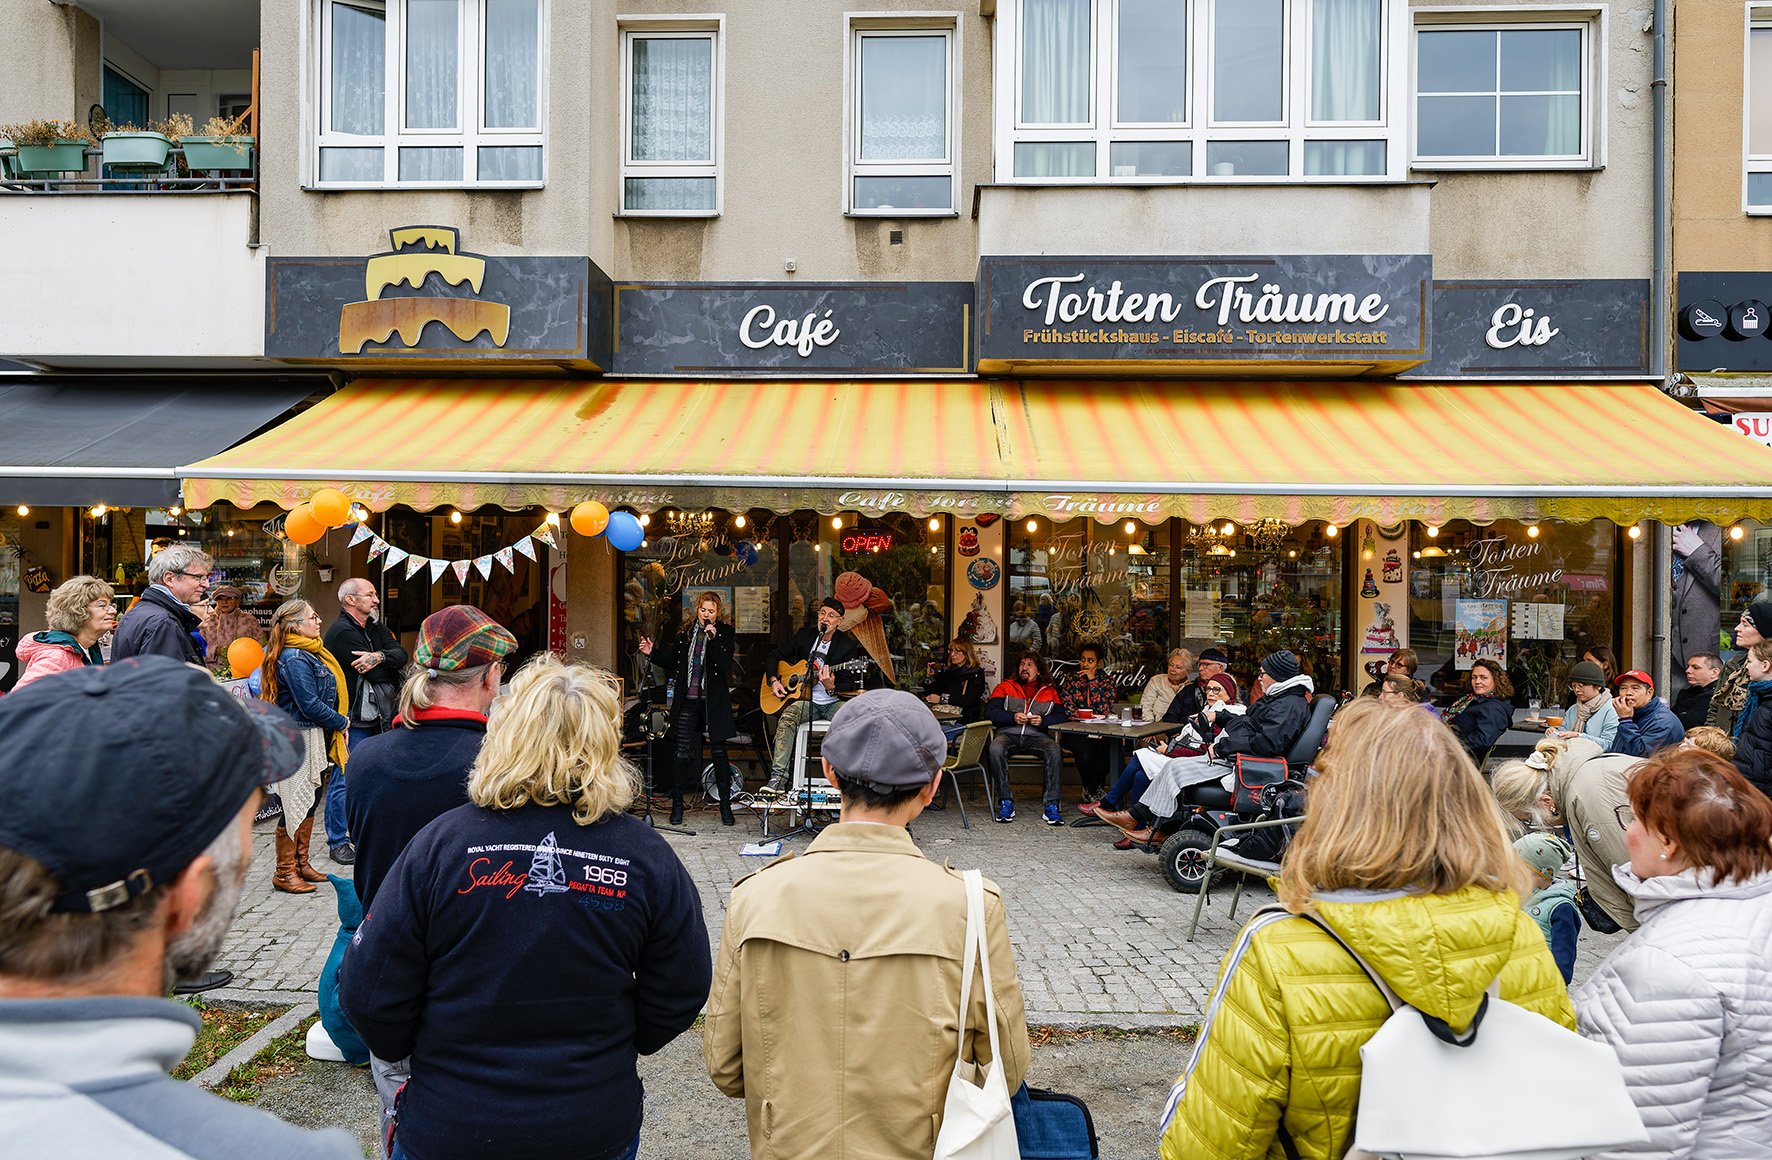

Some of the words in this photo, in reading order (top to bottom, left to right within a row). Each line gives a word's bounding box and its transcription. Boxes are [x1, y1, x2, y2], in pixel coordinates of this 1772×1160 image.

[1022, 272, 1182, 326] Torten
[1194, 272, 1390, 326] Träume
[739, 304, 841, 357] Café
[1023, 328, 1160, 344] Frühstückshaus
[1173, 328, 1234, 344] Eiscafé
[1246, 329, 1387, 344] Tortenwerkstatt
[1485, 303, 1560, 349] Eis
[1042, 495, 1161, 513] Träume
[660, 529, 729, 567] Torten
[842, 535, 892, 551] OPEN
[1044, 530, 1116, 564] Torten
[1466, 534, 1543, 569] Torten
[664, 559, 747, 596] Träume
[1472, 564, 1564, 599] Träume
[467, 845, 486, 854] ROYAL
[485, 844, 503, 852] YACHT
[503, 843, 537, 852] REGISTERED
[572, 849, 599, 860] NINETEEN
[598, 854, 615, 863] SIXTY
[614, 857, 631, 866] EIGHT
[457, 857, 528, 900] Sailing
[568, 880, 596, 893] REGATTA
[597, 885, 615, 896] TEAM
[582, 864, 628, 886] 1968
